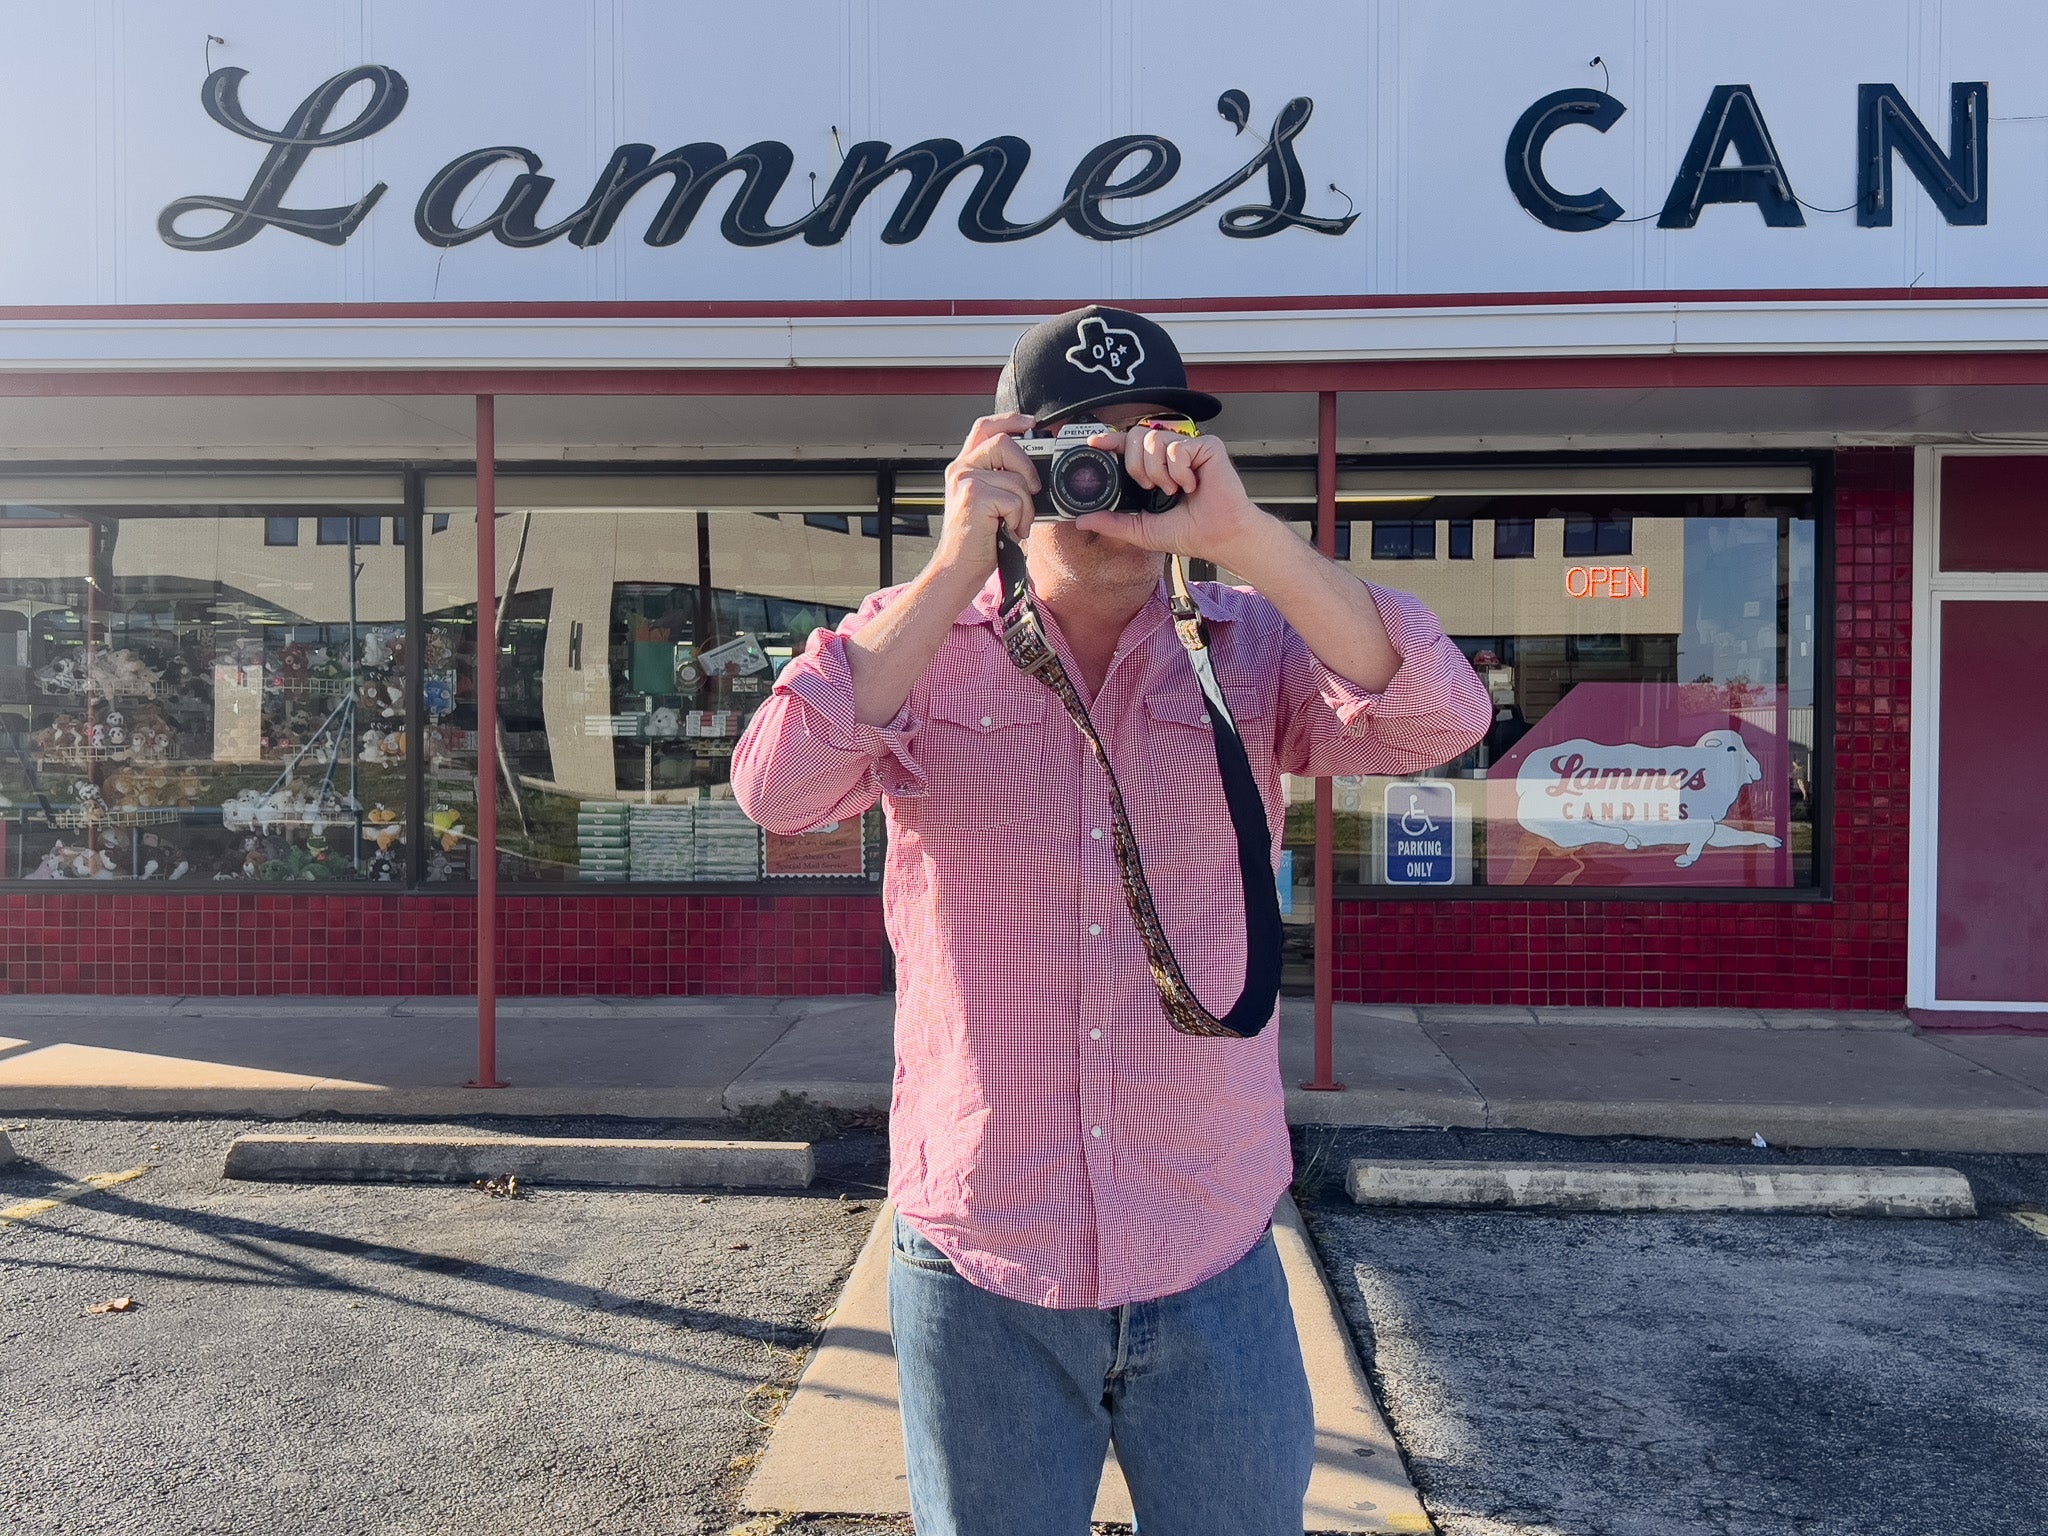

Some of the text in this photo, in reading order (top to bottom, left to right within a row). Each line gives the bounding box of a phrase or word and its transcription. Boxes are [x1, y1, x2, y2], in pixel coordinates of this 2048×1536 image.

[157, 65, 1989, 251] Lamme's CAN
[1064, 428, 1105, 436] PENTAX
[1565, 566, 1648, 598] OPEN
[1545, 753, 1707, 797] Lammes
[1562, 802, 1689, 821] CANDIES
[1397, 840, 1442, 856] PARKING
[1406, 862, 1433, 878] ONLY
